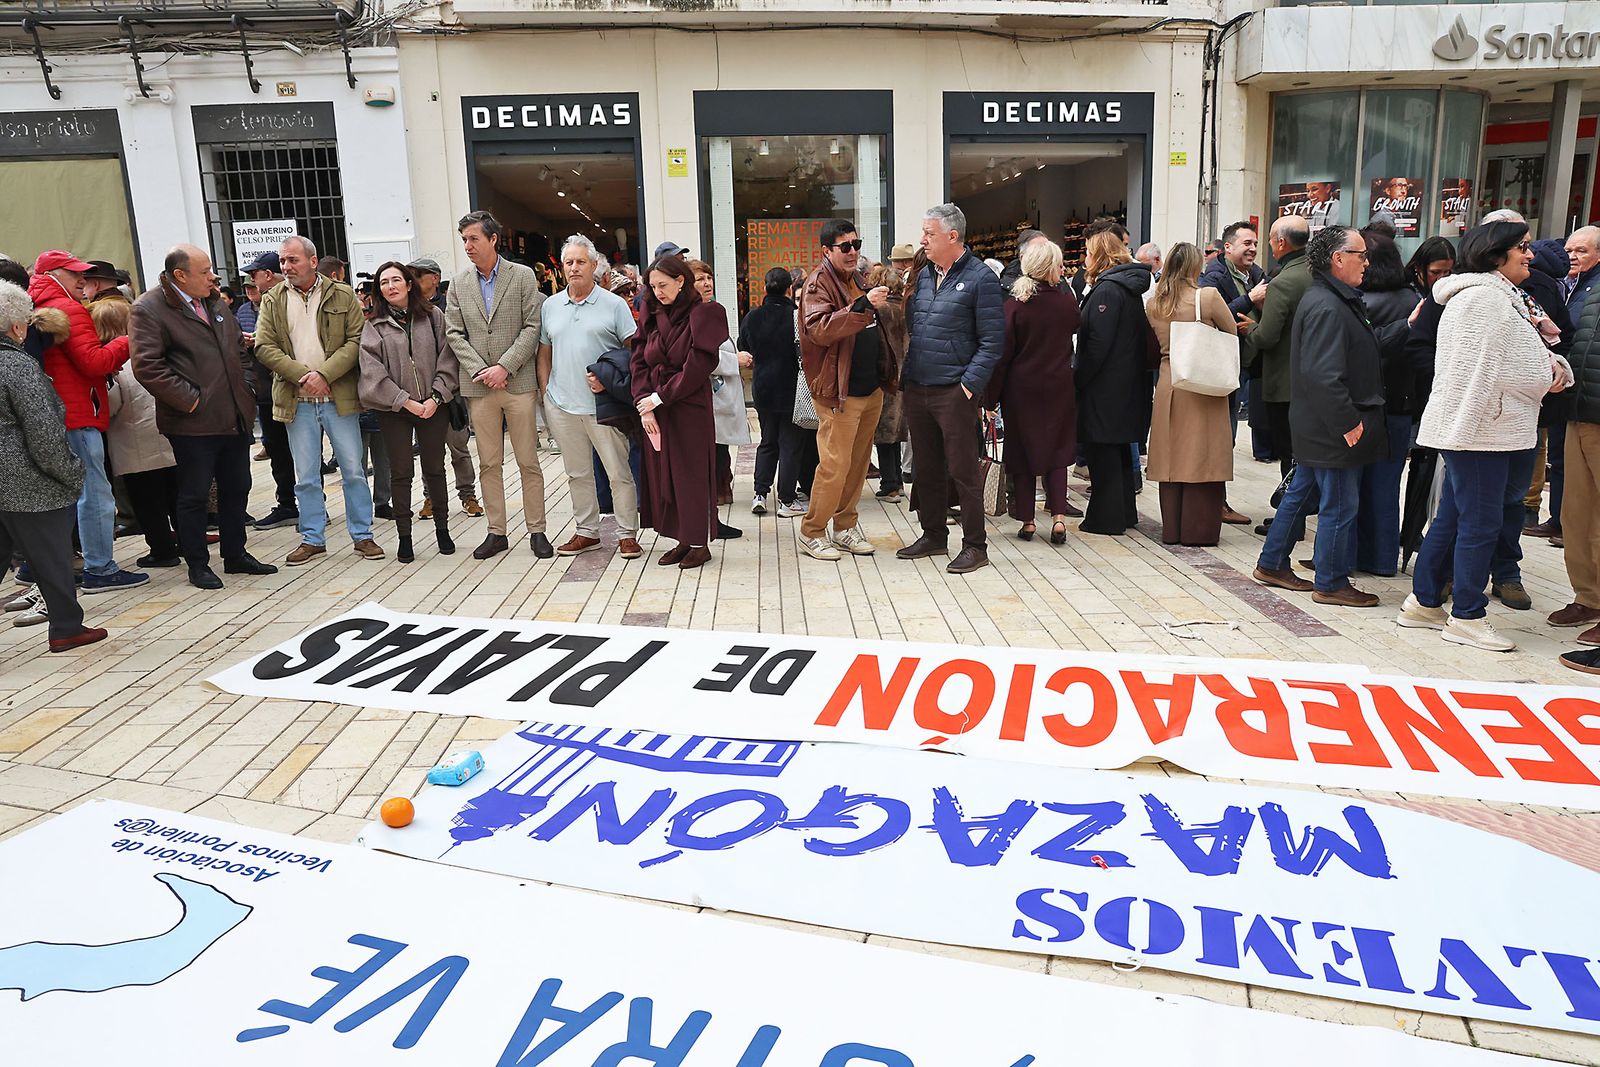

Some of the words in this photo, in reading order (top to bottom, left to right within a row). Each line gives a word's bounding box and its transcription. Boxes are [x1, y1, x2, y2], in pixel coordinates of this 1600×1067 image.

[471, 103, 631, 129] DECIMAS
[983, 101, 1121, 123] DECIMAS
[1284, 200, 1335, 216] START
[1373, 197, 1420, 212] GROWTH
[236, 228, 259, 236] SARA
[260, 226, 293, 235] MERINO
[748, 222, 806, 235] REMATE
[237, 236, 263, 244] CELSO
[748, 237, 807, 250] REMATE
[749, 251, 808, 264] REMATE
[252, 618, 670, 708] PLAYAS
[692, 645, 817, 697] DE
[114, 818, 238, 852] Portileñ@s
[529, 781, 1398, 880] MAZAGÓN
[111, 838, 144, 853] de
[143, 844, 280, 882] Asociación
[238, 844, 333, 873] Vecinos
[236, 933, 470, 1049] VÉ
